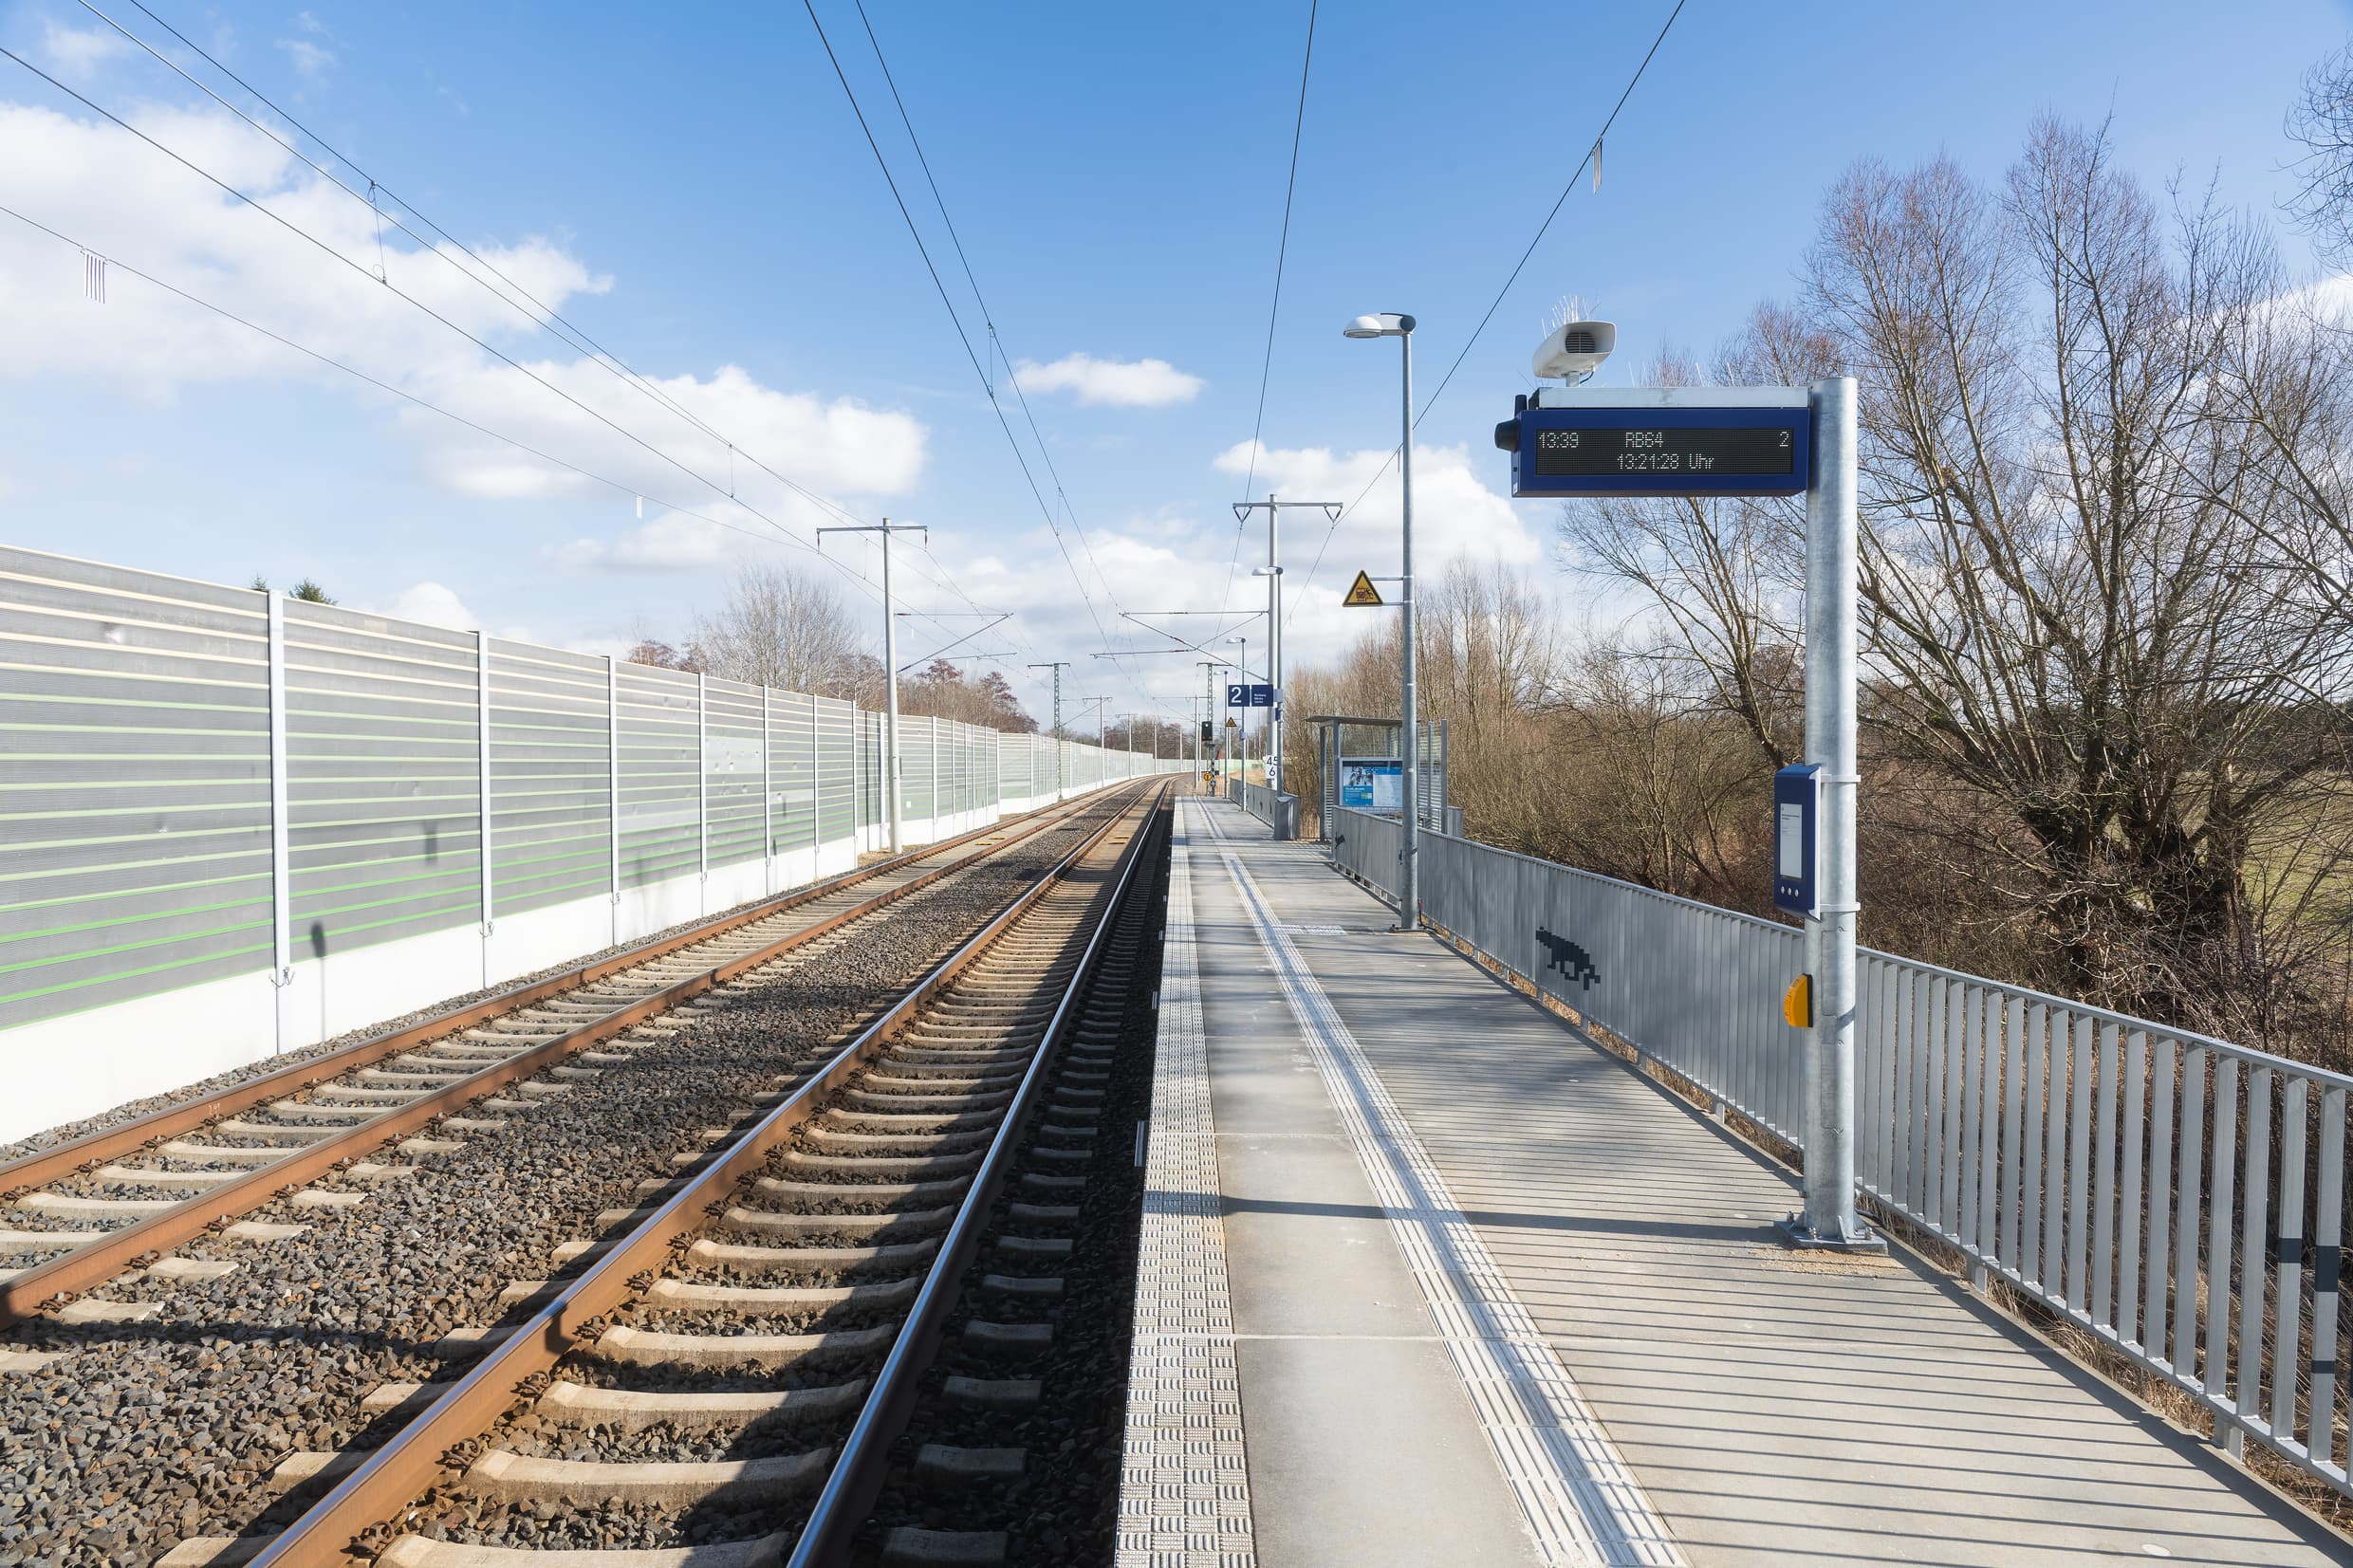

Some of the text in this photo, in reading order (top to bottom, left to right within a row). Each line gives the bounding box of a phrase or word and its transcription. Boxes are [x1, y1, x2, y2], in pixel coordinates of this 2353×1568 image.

[1539, 432, 1789, 449] 13:39 RB64 2
[1617, 453, 1714, 470] 13:21:28 Uhr
[1231, 686, 1242, 704] 2
[1269, 766, 1276, 777] 6
